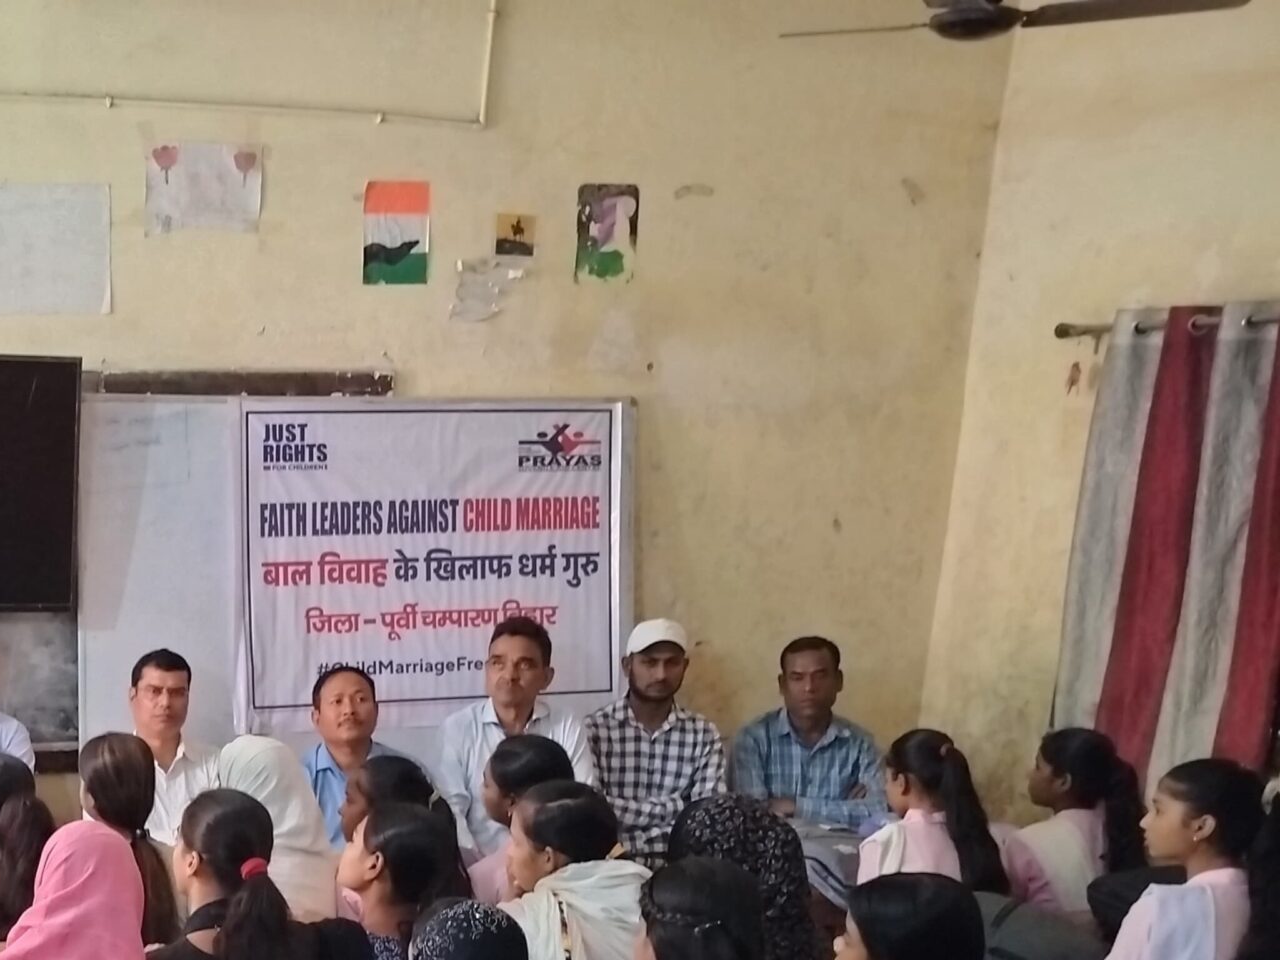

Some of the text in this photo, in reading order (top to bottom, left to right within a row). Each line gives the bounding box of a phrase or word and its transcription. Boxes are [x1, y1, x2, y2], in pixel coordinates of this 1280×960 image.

[263, 423, 308, 442] JUST
[263, 443, 328, 462] RIGHTS
[518, 455, 602, 467] PRAYAS
[260, 496, 600, 537] FAITH LEADERS AGAINST CHILD MARRIAGE
[262, 545, 600, 588] बाल विवाह के खिलाफ धर्म गुरु
[305, 607, 360, 634] जिला
[381, 603, 419, 640] पूर्वी
[421, 608, 498, 629] चम्पारण
